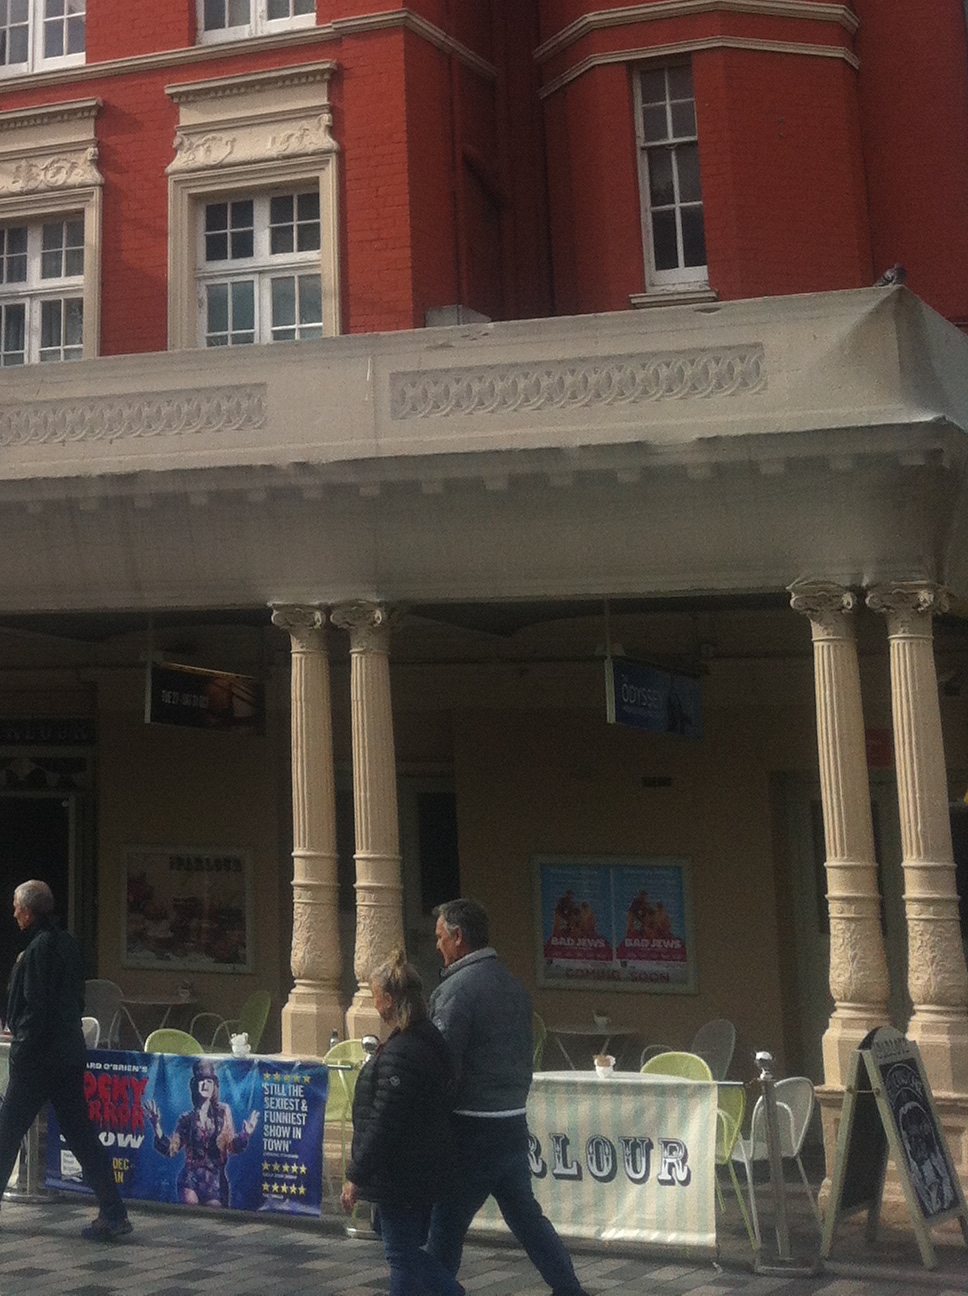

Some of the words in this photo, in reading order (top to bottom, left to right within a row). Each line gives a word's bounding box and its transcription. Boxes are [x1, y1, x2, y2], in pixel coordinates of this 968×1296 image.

[551, 936, 576, 946] BAD
[577, 937, 606, 947] JEWS
[625, 938, 649, 947] BAD
[650, 938, 682, 949] JEWS
[103, 1063, 149, 1073] O'BRIEN'S
[288, 1083, 305, 1098] THE
[263, 1096, 300, 1112] SEXIEST
[301, 1098, 308, 1112] &
[263, 1110, 308, 1126] FUNNIEST
[263, 1125, 291, 1139] SHOW
[292, 1127, 302, 1140] IN
[112, 1157, 130, 1171] DEC
